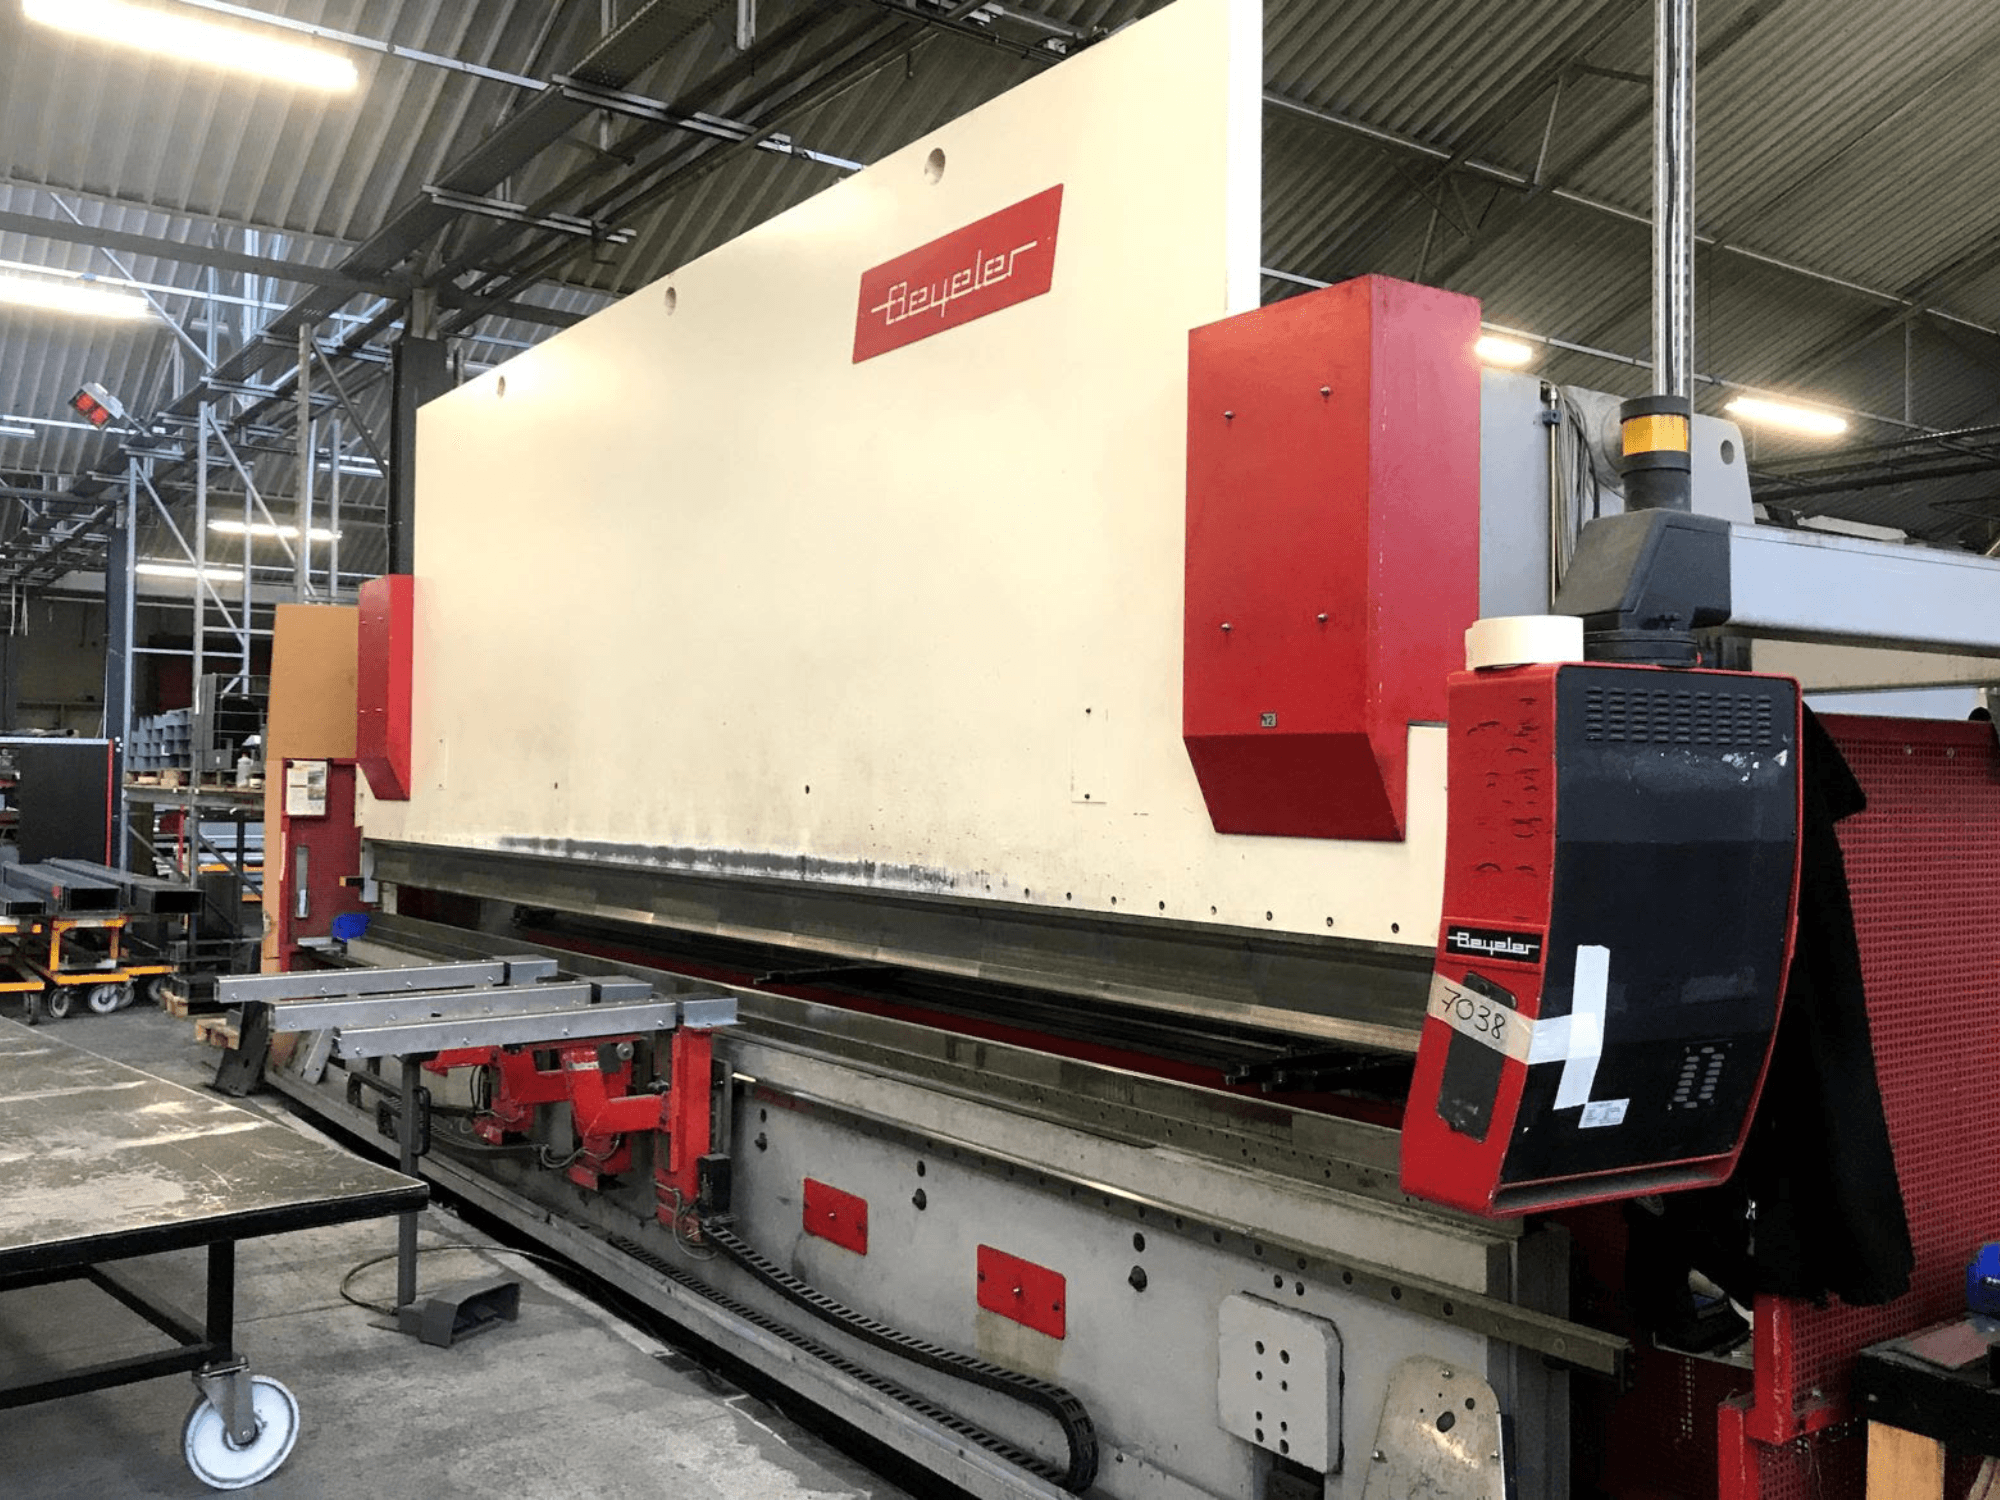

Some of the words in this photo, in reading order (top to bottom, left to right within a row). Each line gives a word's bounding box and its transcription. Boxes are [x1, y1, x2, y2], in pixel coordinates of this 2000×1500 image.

[870, 240, 1038, 325] Beyeler
[1447, 931, 1540, 956] Beyeler
[1441, 985, 1506, 1040] 7038
